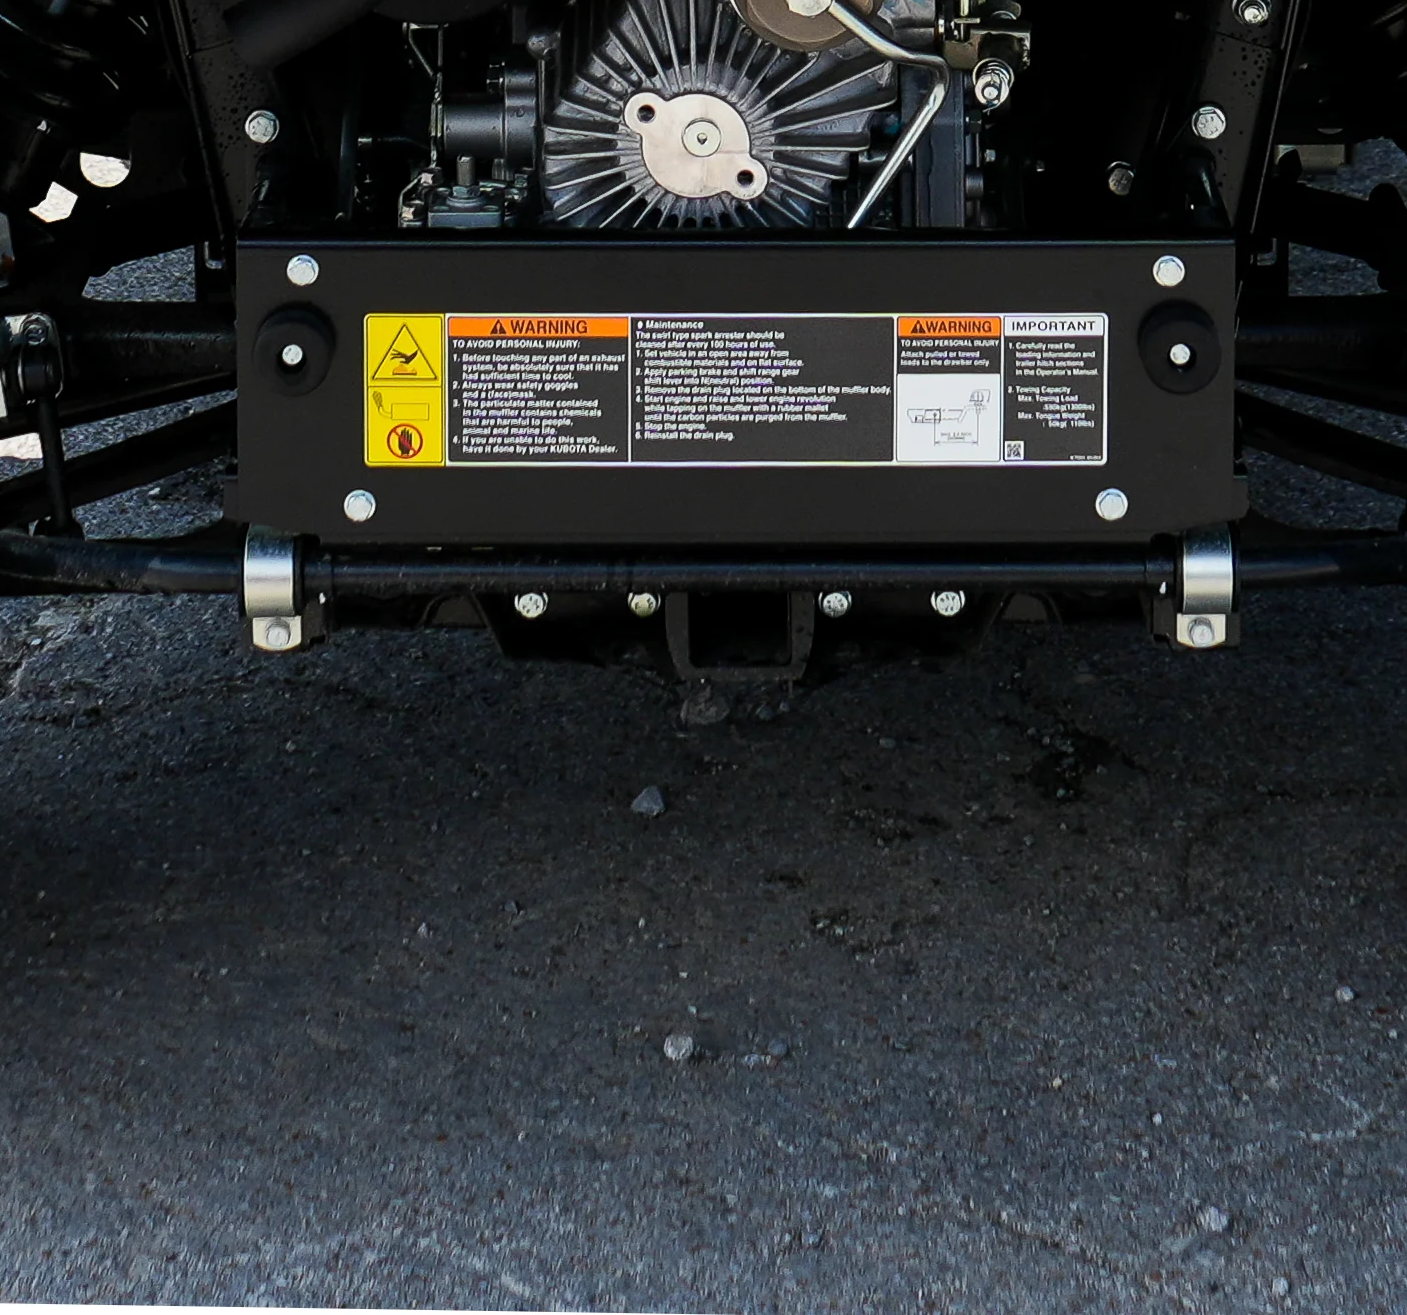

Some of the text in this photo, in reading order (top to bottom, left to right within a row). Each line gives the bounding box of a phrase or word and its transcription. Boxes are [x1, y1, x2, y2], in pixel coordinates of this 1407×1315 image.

[510, 320, 588, 334] WARNING
[645, 321, 704, 329] Maintenance
[925, 321, 992, 333] WARNING
[1012, 321, 1095, 331] IMPORTANT
[452, 340, 464, 348] TO
[466, 340, 494, 348] AVOID
[495, 340, 544, 348] PERSONAL
[900, 339, 911, 347] TO
[911, 339, 934, 347] AVOID
[934, 339, 972, 347] PERSONAL
[550, 445, 587, 453] KUBOTA
